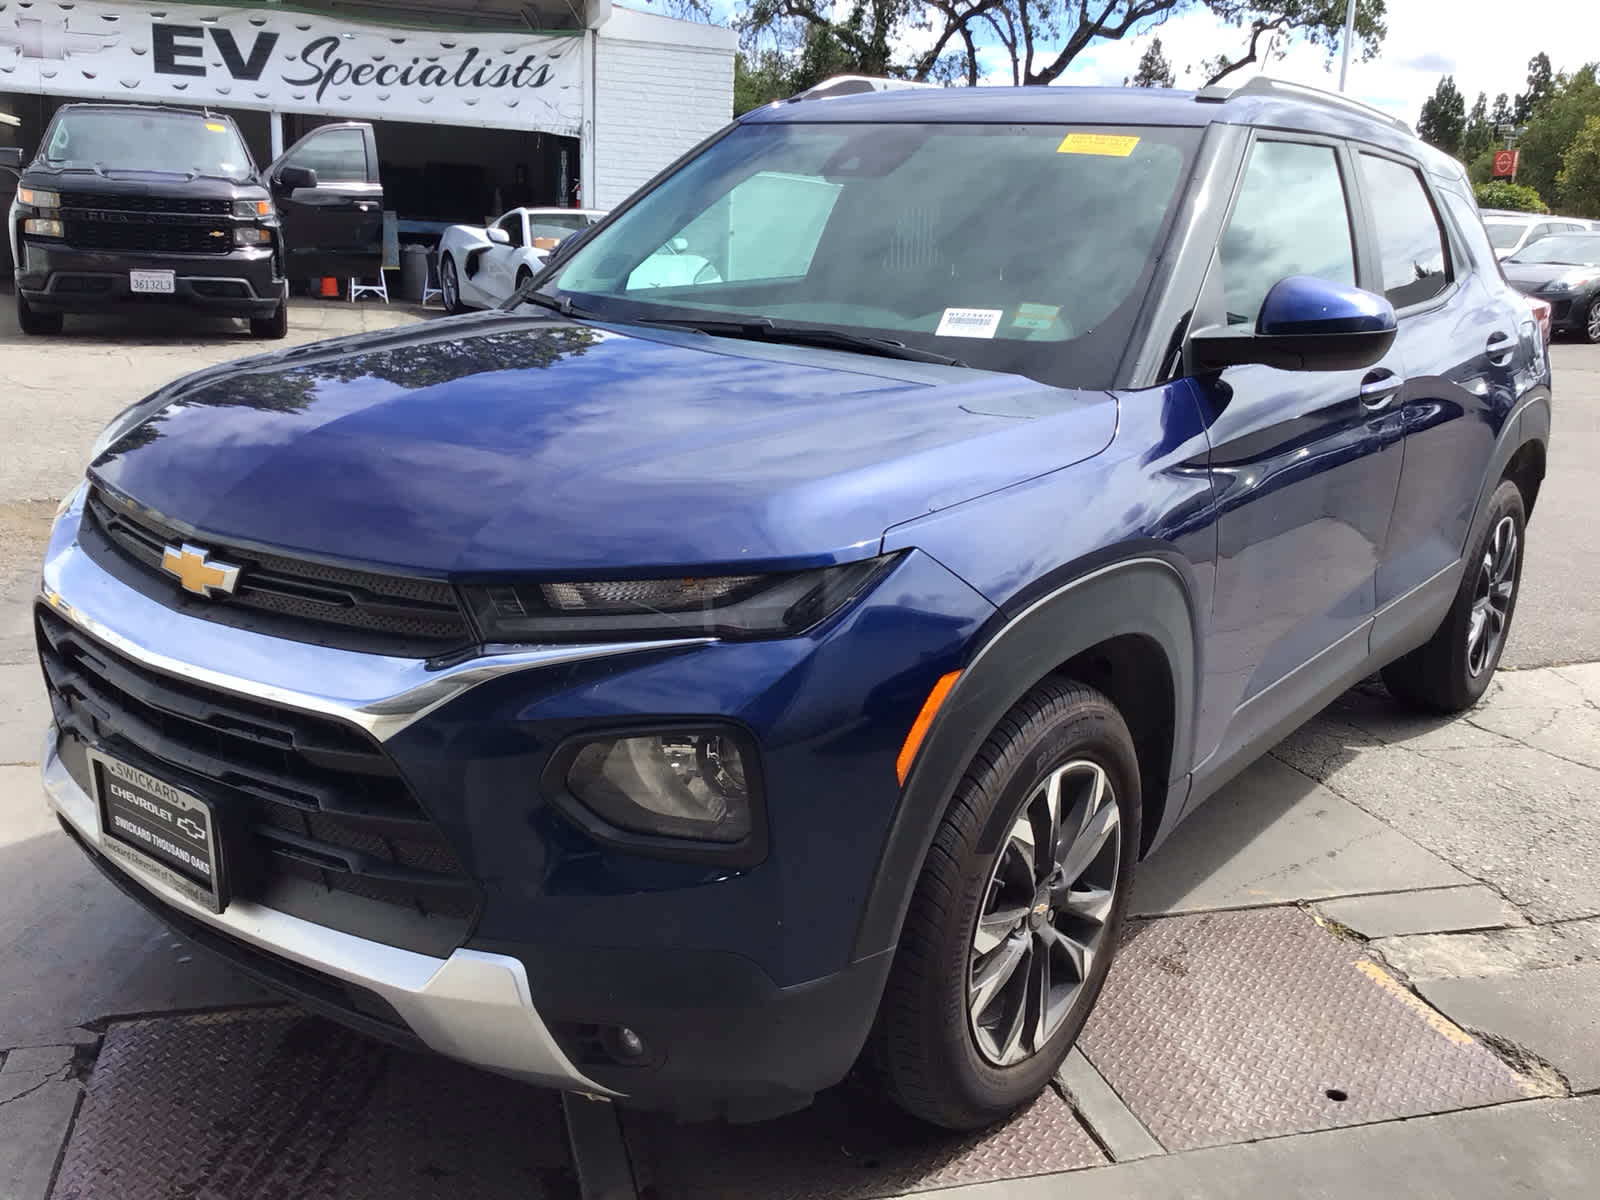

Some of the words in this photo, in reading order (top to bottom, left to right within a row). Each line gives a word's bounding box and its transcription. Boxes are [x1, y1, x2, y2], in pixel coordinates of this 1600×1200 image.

[152, 23, 280, 81] EV
[281, 36, 555, 103] Specialists
[110, 784, 173, 822] CHEVROLET
[116, 763, 179, 803] SWICKARD
[114, 815, 151, 842] SWICKARD
[152, 834, 190, 863] THOUSAND
[191, 855, 210, 875] OAKS
